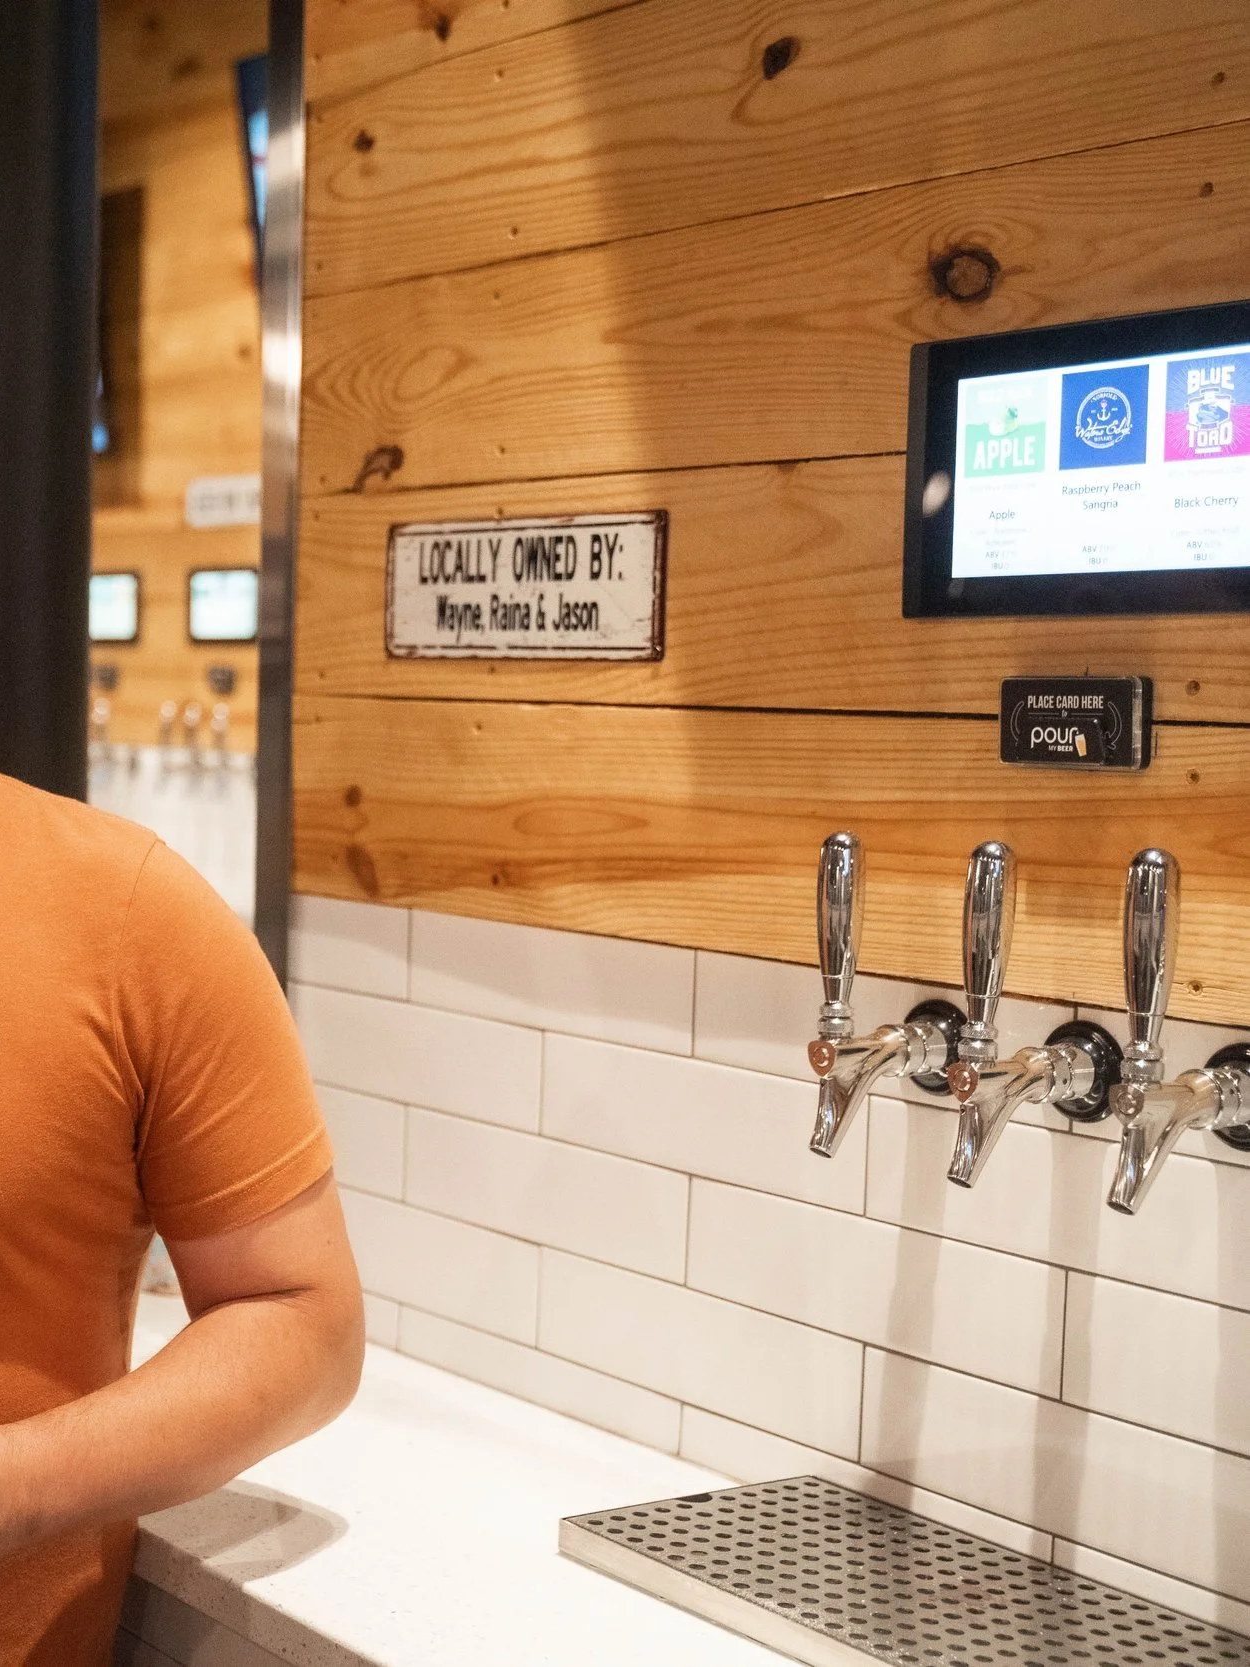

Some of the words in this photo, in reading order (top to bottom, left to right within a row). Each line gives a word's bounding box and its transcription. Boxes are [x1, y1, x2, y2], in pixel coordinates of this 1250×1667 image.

[1187, 366, 1235, 396] BLUE
[1186, 421, 1233, 448] TOAD
[973, 435, 1036, 470] APPLE
[1062, 484, 1109, 496] Raspberry
[1113, 481, 1141, 492] Peach
[1083, 499, 1118, 511] Sangria
[1174, 497, 1200, 508] Black
[1204, 496, 1239, 508] Cherry
[989, 508, 1016, 520] Apple
[419, 539, 502, 585] LOCALLY
[512, 536, 577, 582] OWNED
[590, 533, 623, 581] BY:
[436, 595, 485, 644] Wayne,
[489, 594, 530, 631] Raina
[536, 594, 546, 631] &
[552, 593, 599, 631] Jason
[1027, 695, 1054, 709] PLACE
[1056, 695, 1079, 709] CARD
[1081, 695, 1104, 709] HERE
[1061, 709, 1068, 718] to
[1030, 727, 1078, 749] pour
